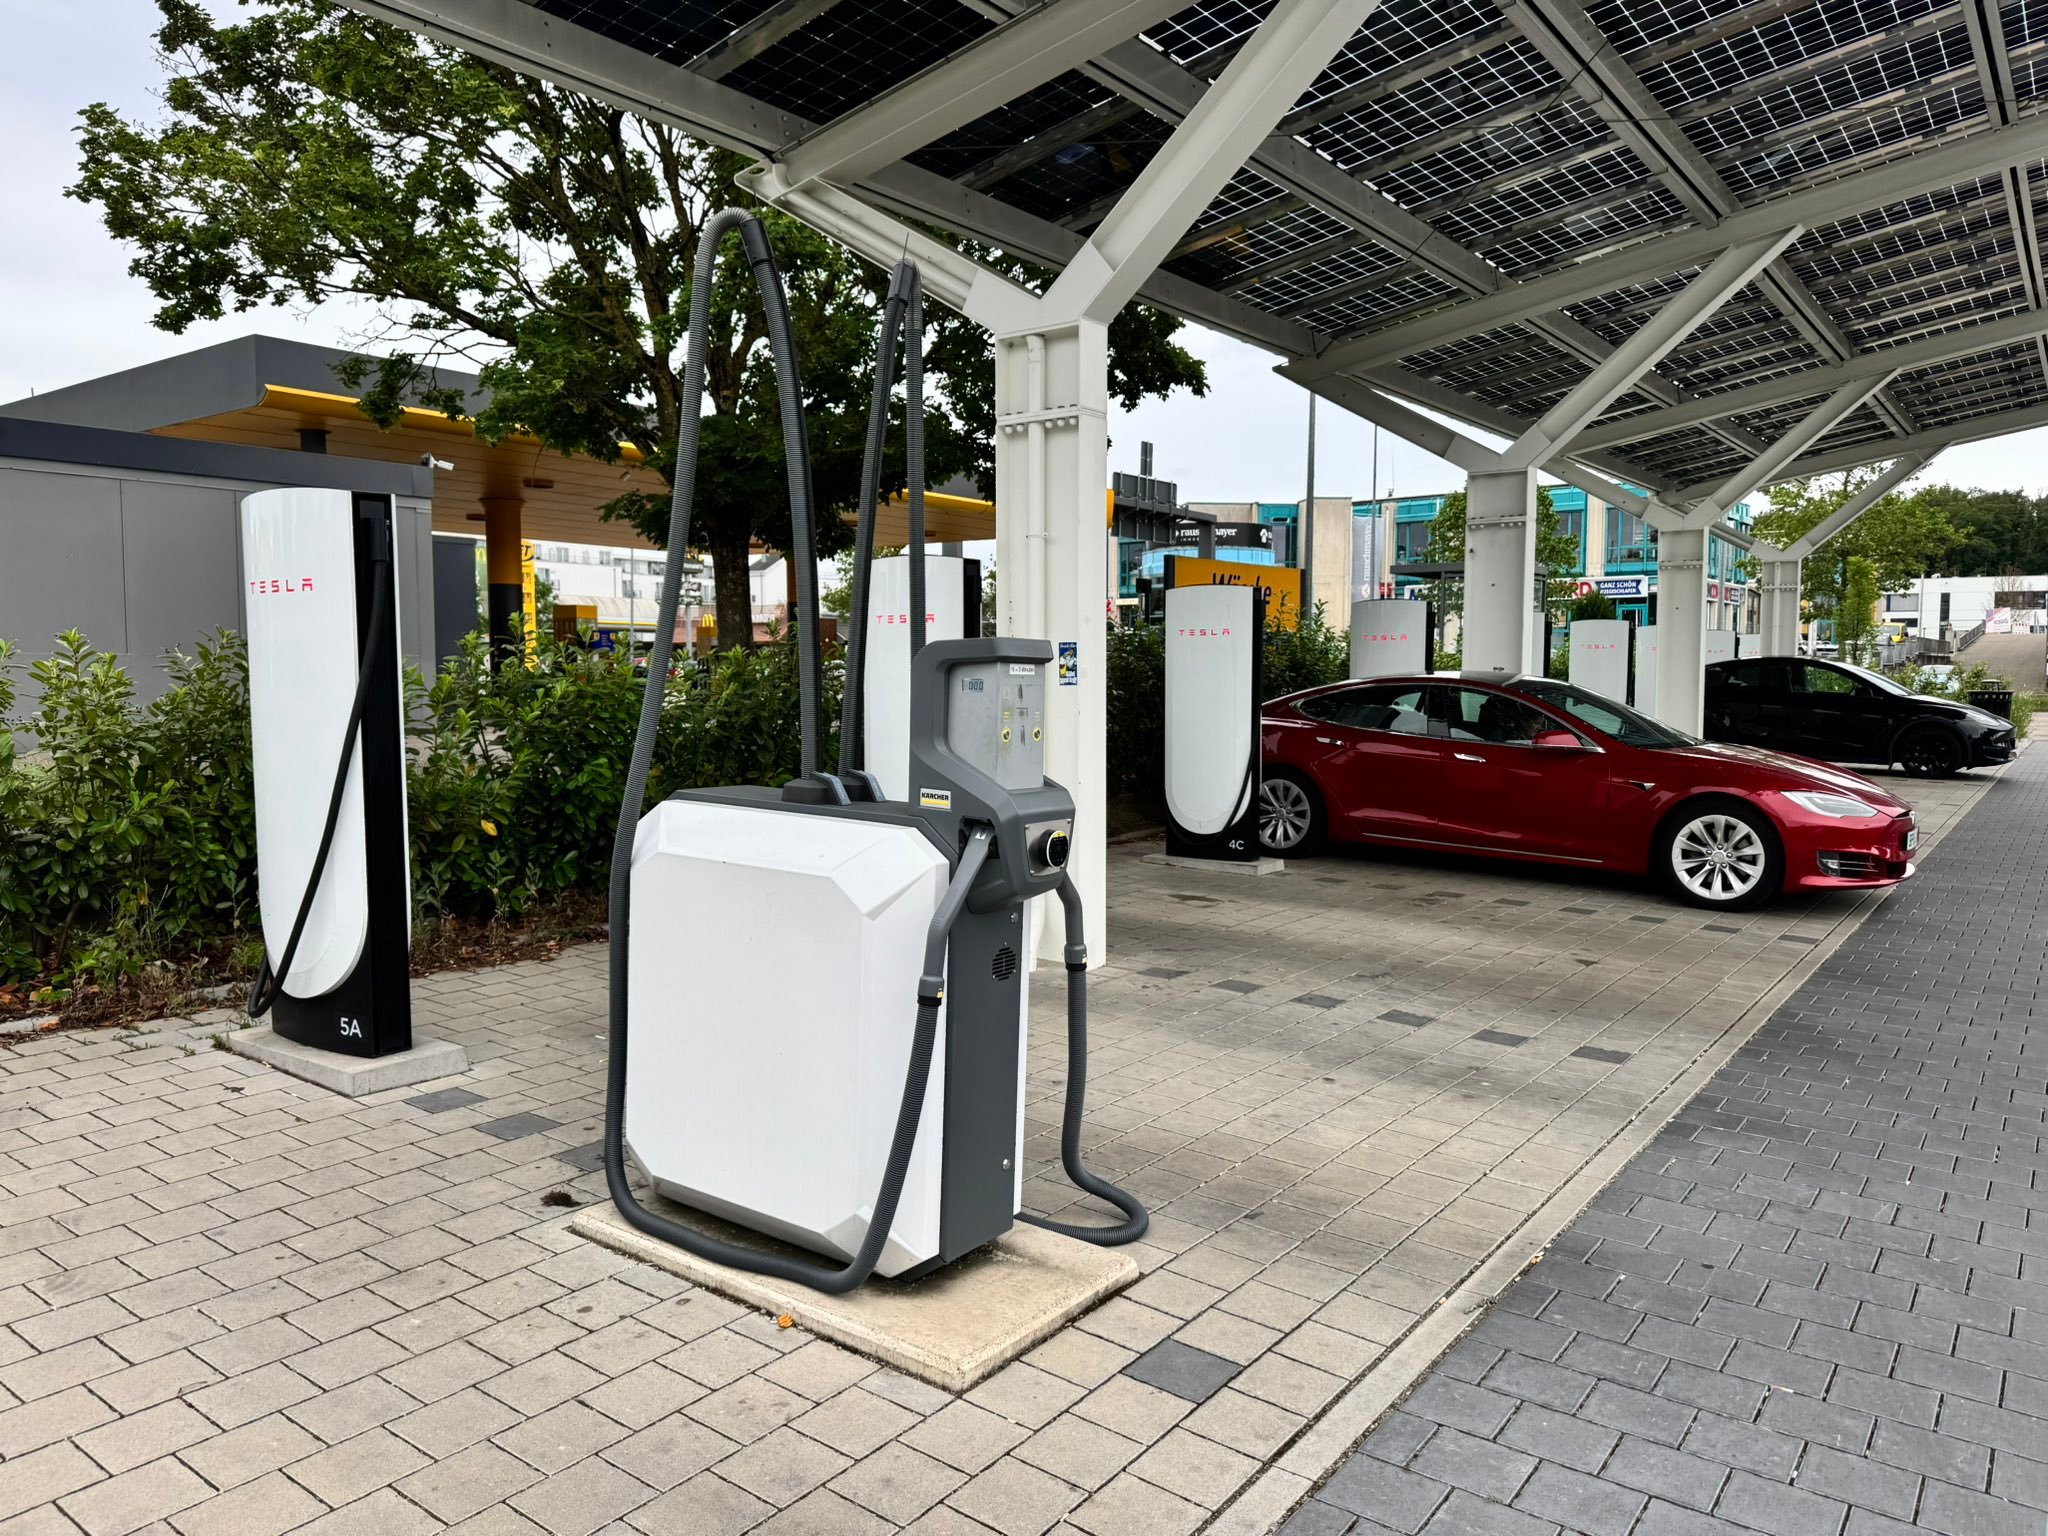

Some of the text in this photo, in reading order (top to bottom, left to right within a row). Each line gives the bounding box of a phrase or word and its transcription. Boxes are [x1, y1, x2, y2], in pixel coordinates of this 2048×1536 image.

[250, 578, 312, 594] TESLA
[1616, 580, 1636, 588] SCHÖN
[876, 613, 935, 624] TESA
[1179, 628, 1231, 636] TESLA
[1228, 839, 1245, 850] 4C
[339, 1017, 362, 1038] 5A
